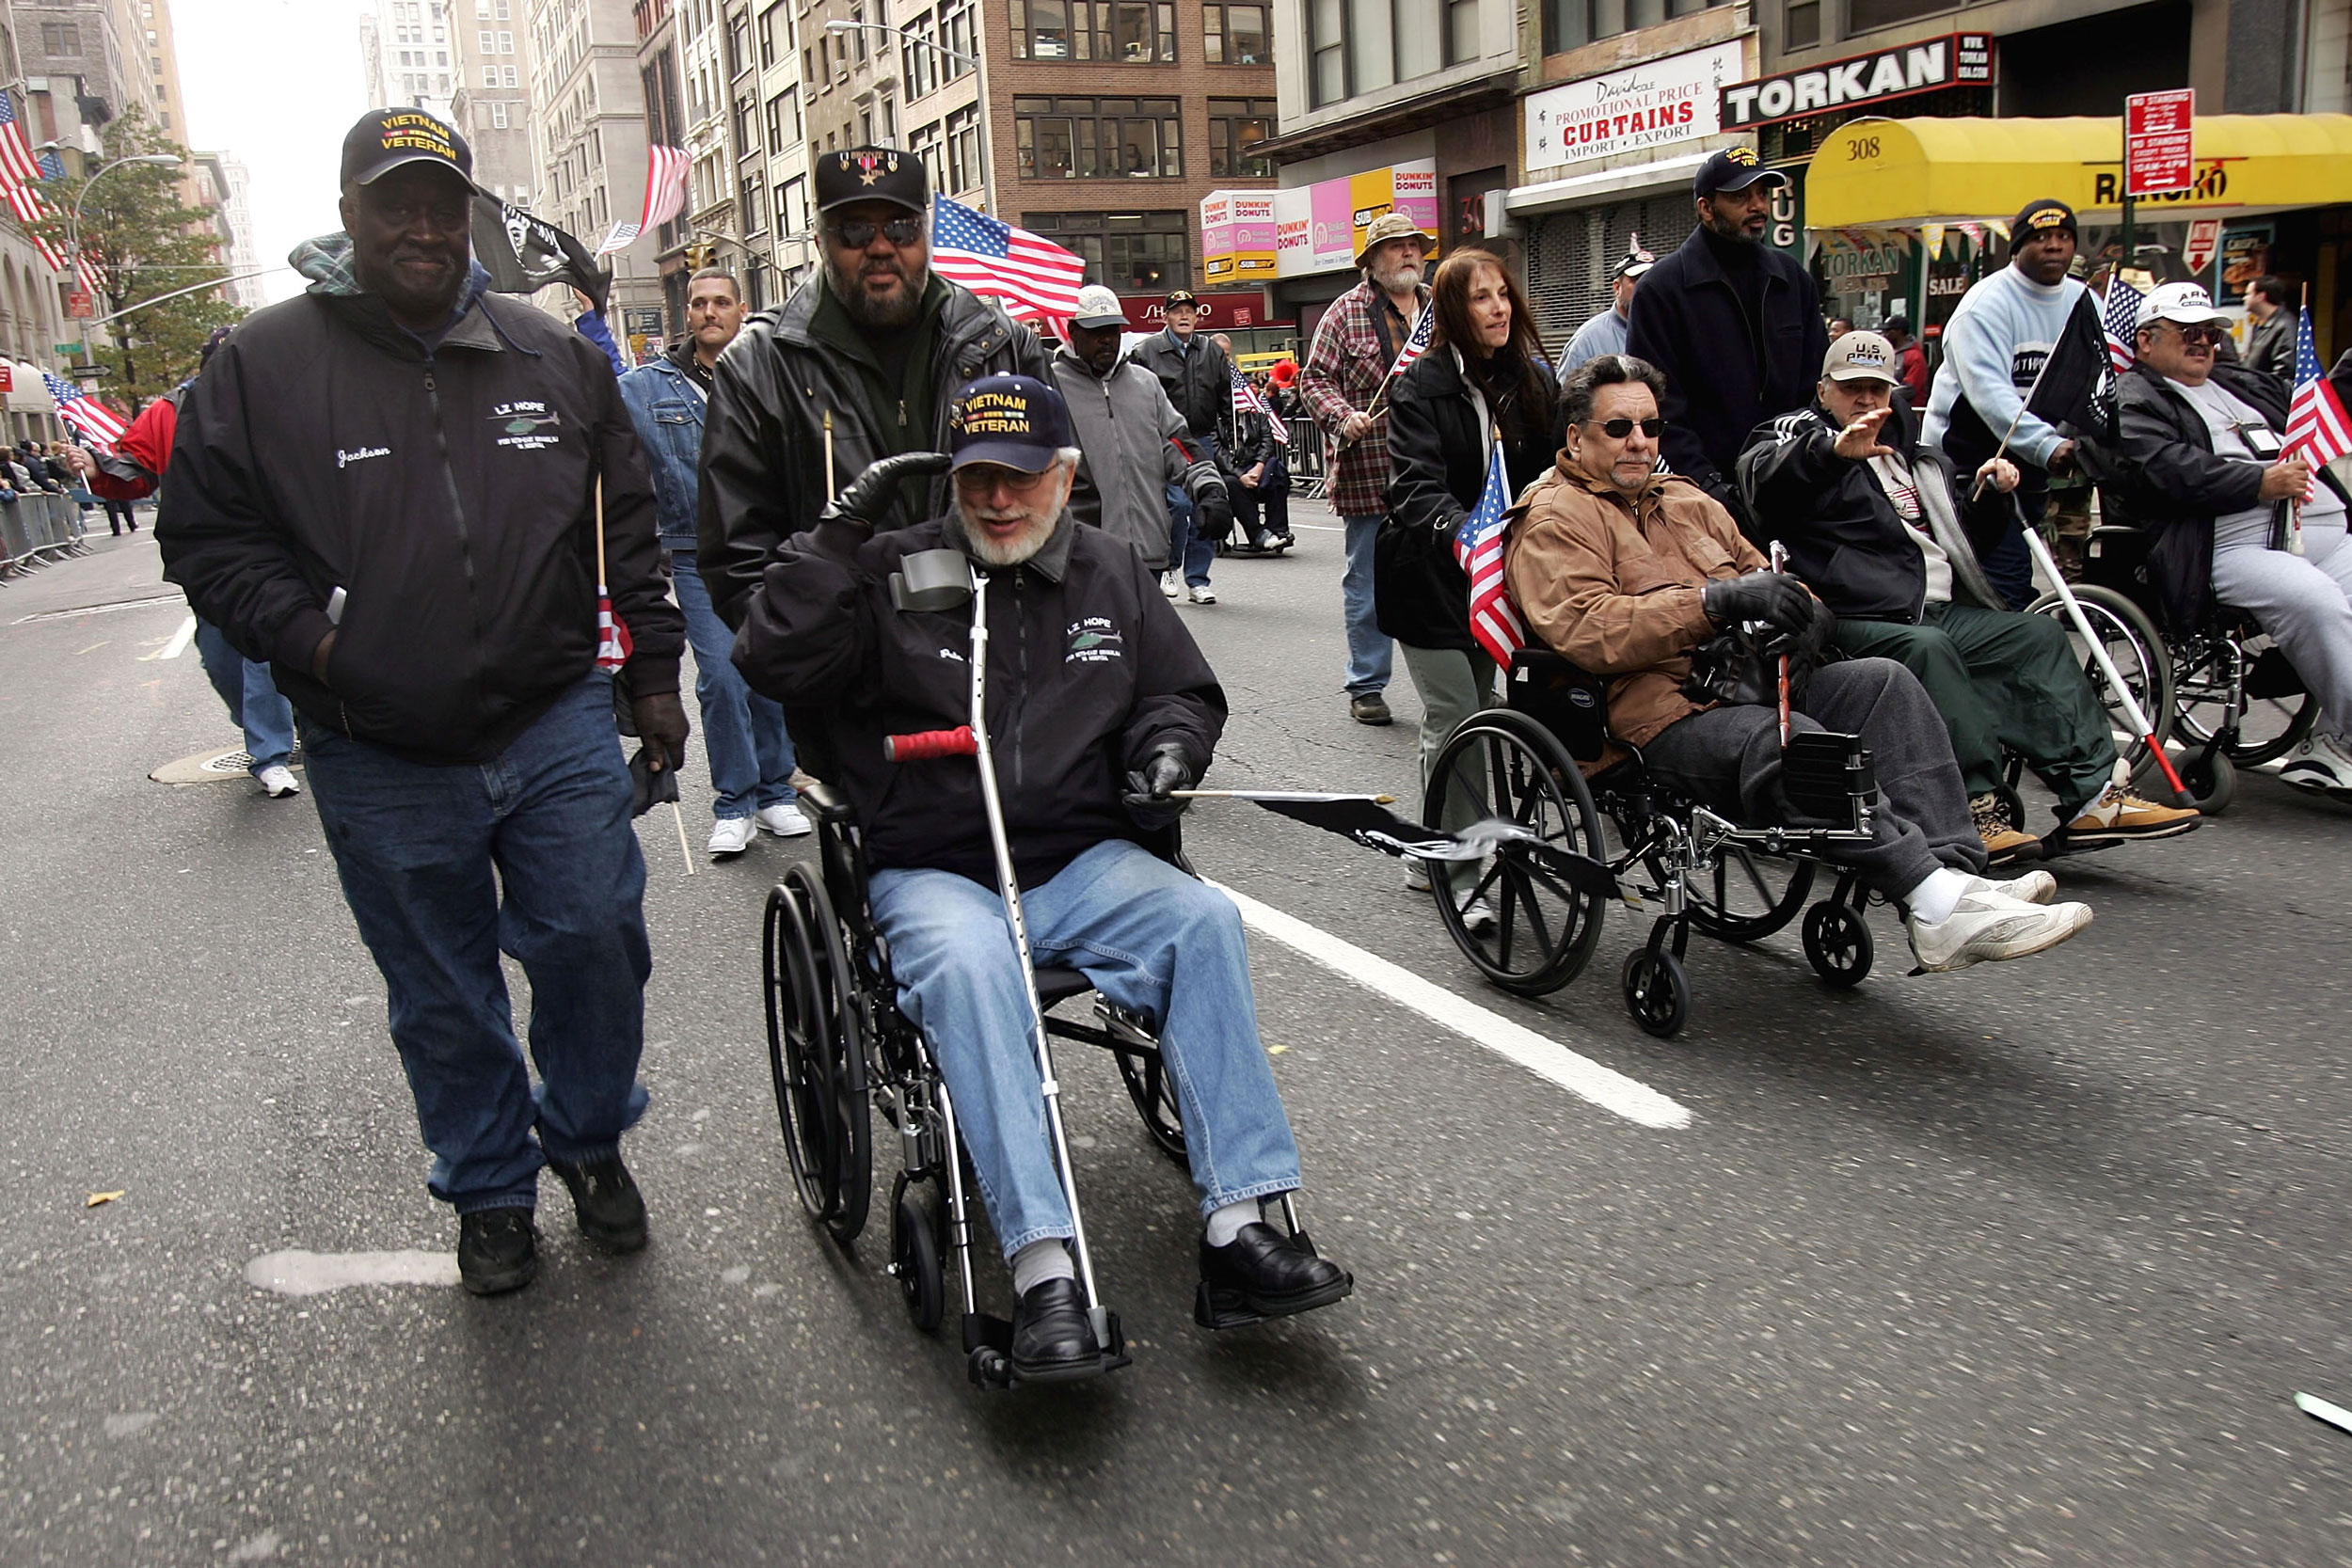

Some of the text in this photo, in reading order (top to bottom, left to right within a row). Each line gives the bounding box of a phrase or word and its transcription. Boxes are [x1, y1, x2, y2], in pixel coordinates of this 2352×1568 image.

[1959, 52, 1988, 63] TORKAN
[1597, 73, 1656, 103] David COLE
[1727, 42, 1946, 123] TORKAN
[1555, 81, 1703, 126] PROMOTIONAL PRICE
[2147, 92, 2189, 104] STANDING
[381, 114, 450, 140] VIETNAM
[1563, 101, 1693, 147] CURTAINS
[381, 136, 456, 161] VETERAN
[1565, 123, 1692, 160] IMPORT EXPORT
[1846, 136, 1880, 161] 308
[2147, 135, 2189, 147] STANDING
[850, 151, 883, 160] BRONZE
[2095, 171, 2204, 204] RCH
[1278, 234, 1308, 249] DONUTS
[1821, 247, 1899, 279] TORKAN
[1930, 277, 1964, 295] SALE
[494, 402, 546, 415] LZ HOPE
[965, 393, 1026, 413] VIETNAM
[963, 420, 1030, 436] VETERAN
[337, 446, 390, 468] Jackson
[1067, 617, 1111, 635] LZ HOPE
